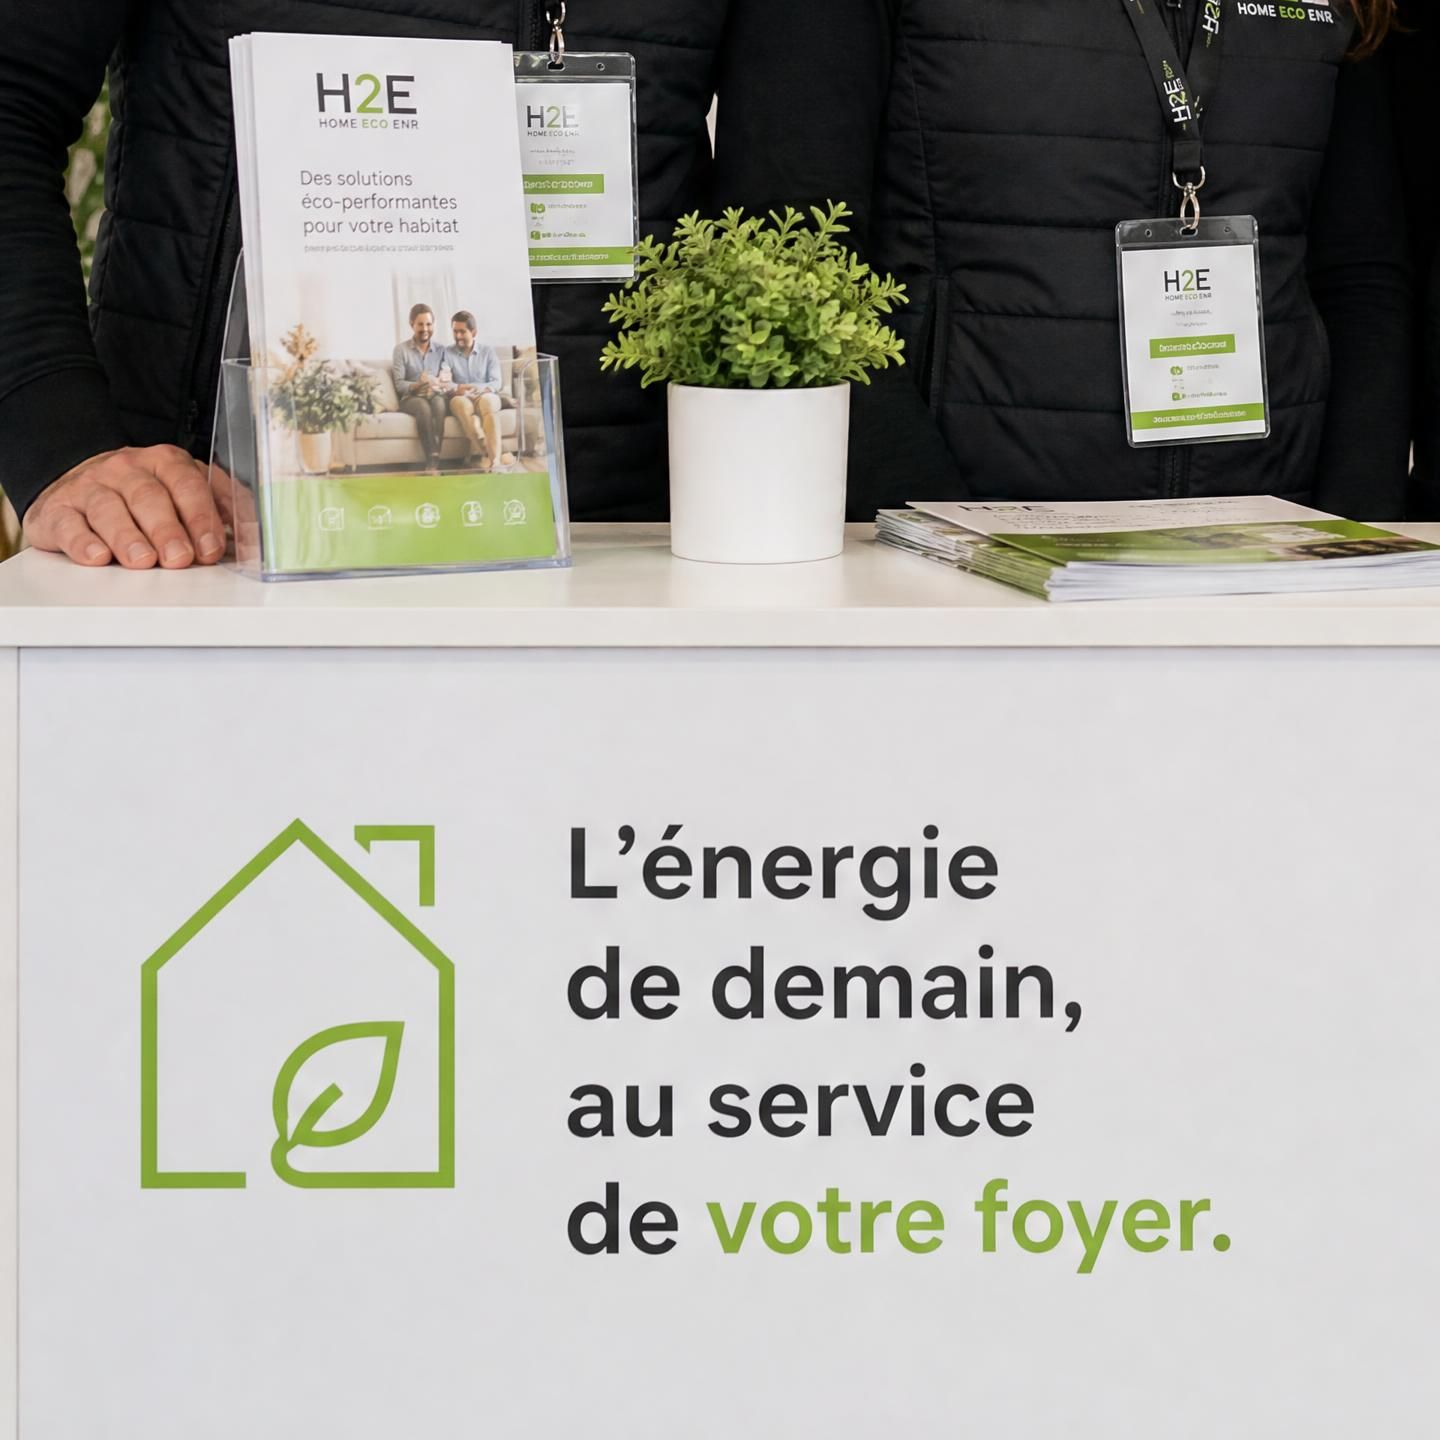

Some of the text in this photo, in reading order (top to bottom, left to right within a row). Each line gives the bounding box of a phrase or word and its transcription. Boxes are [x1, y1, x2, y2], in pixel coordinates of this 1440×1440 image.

[1237, 2, 1334, 24] HOME ECO ENR
[316, 72, 417, 115] H2E
[319, 118, 419, 130] HOME ECO ENR
[527, 105, 579, 128] H2E
[300, 170, 413, 187] Des solutions
[302, 193, 458, 214] éco-performantes
[304, 216, 459, 237] pour votre habitat
[1164, 268, 1211, 292] H2E
[567, 944, 1083, 1033] de demain,
[567, 1062, 1035, 1138] au service
[567, 1178, 1231, 1274] de votre foyer.
